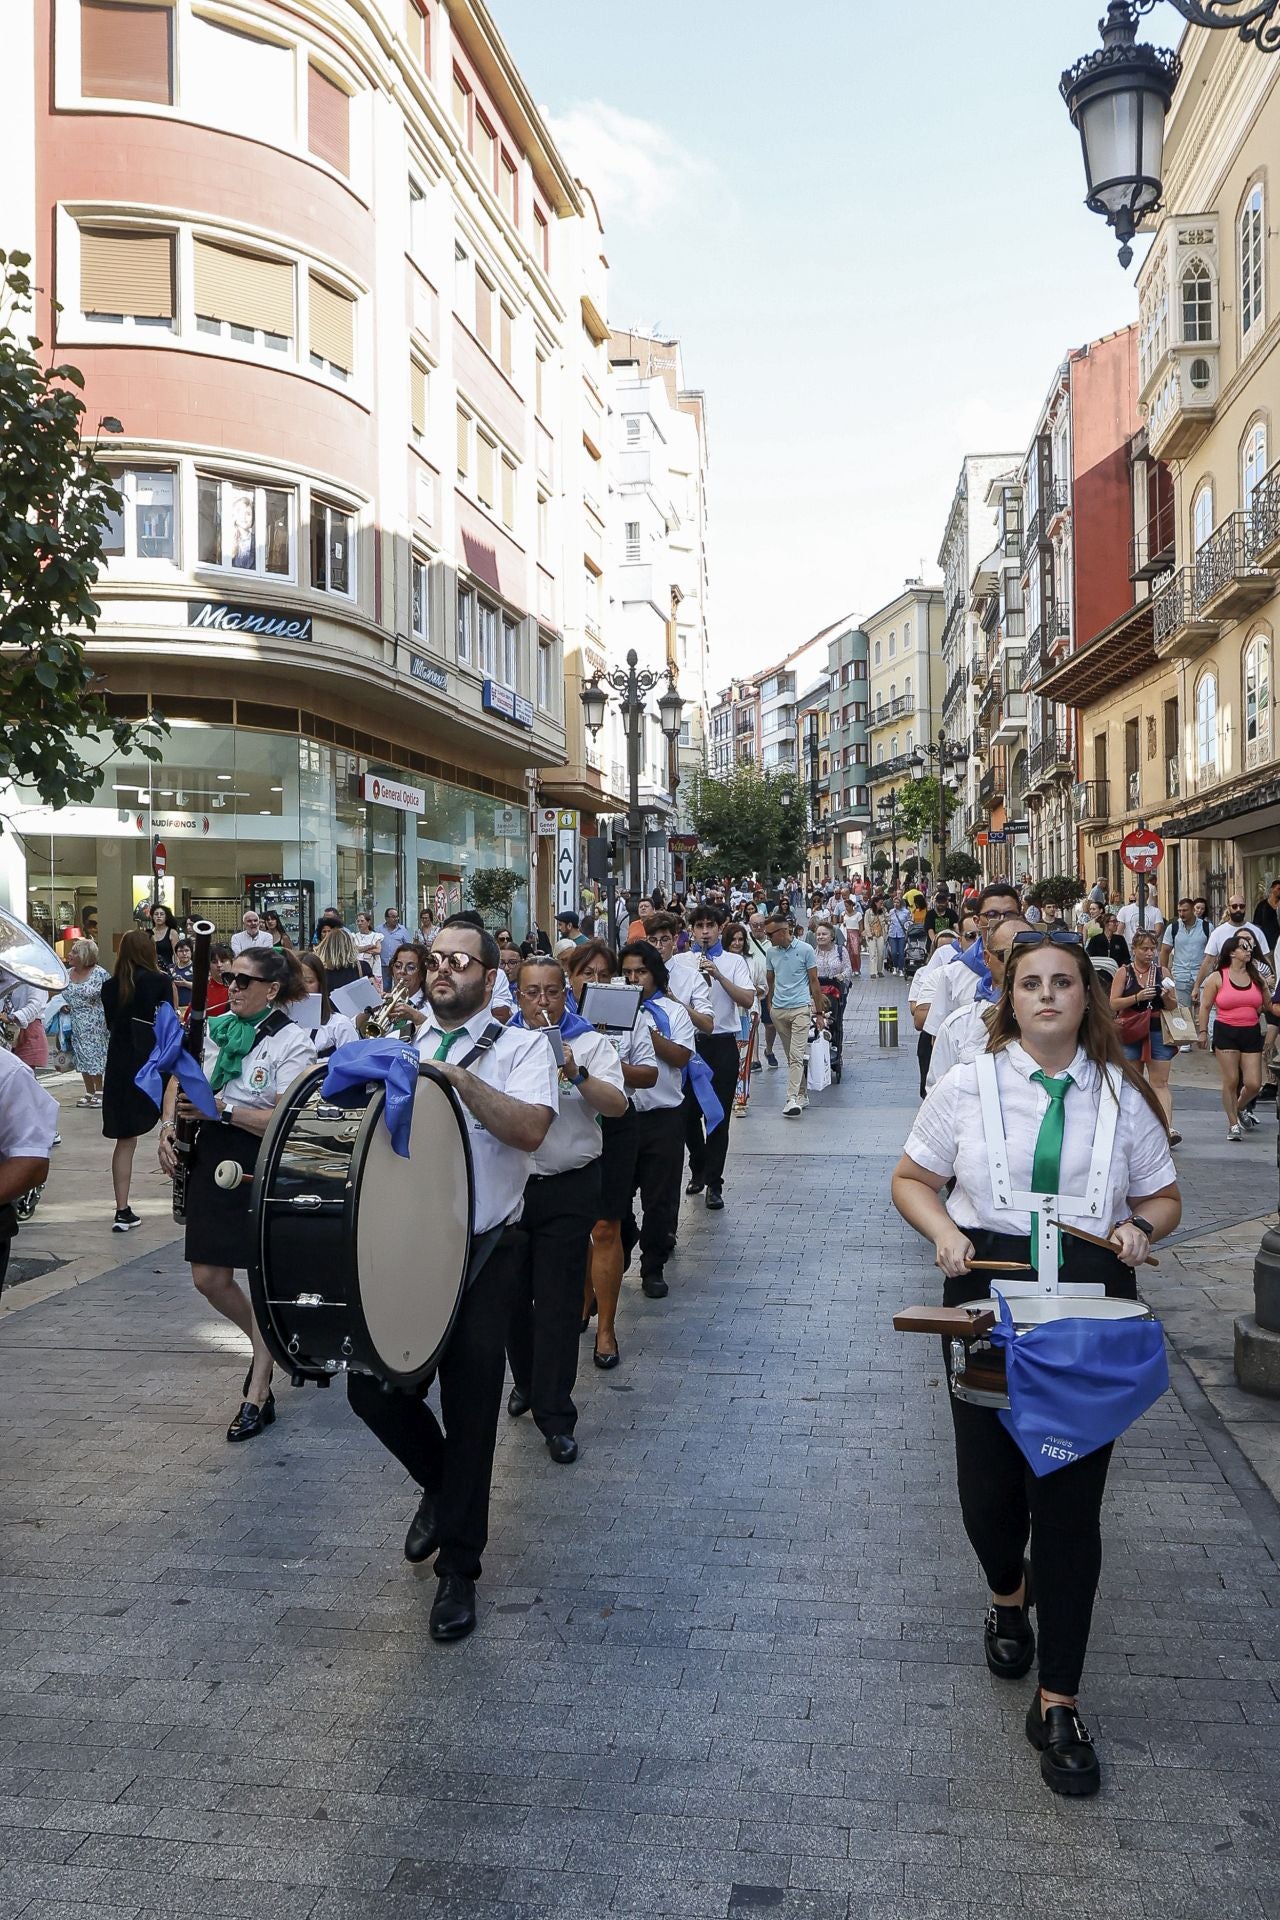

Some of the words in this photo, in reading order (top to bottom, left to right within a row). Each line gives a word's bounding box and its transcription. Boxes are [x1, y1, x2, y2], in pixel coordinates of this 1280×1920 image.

[190, 603, 311, 639] Manuel
[381, 785, 402, 803] General
[402, 791, 420, 807] Optica
